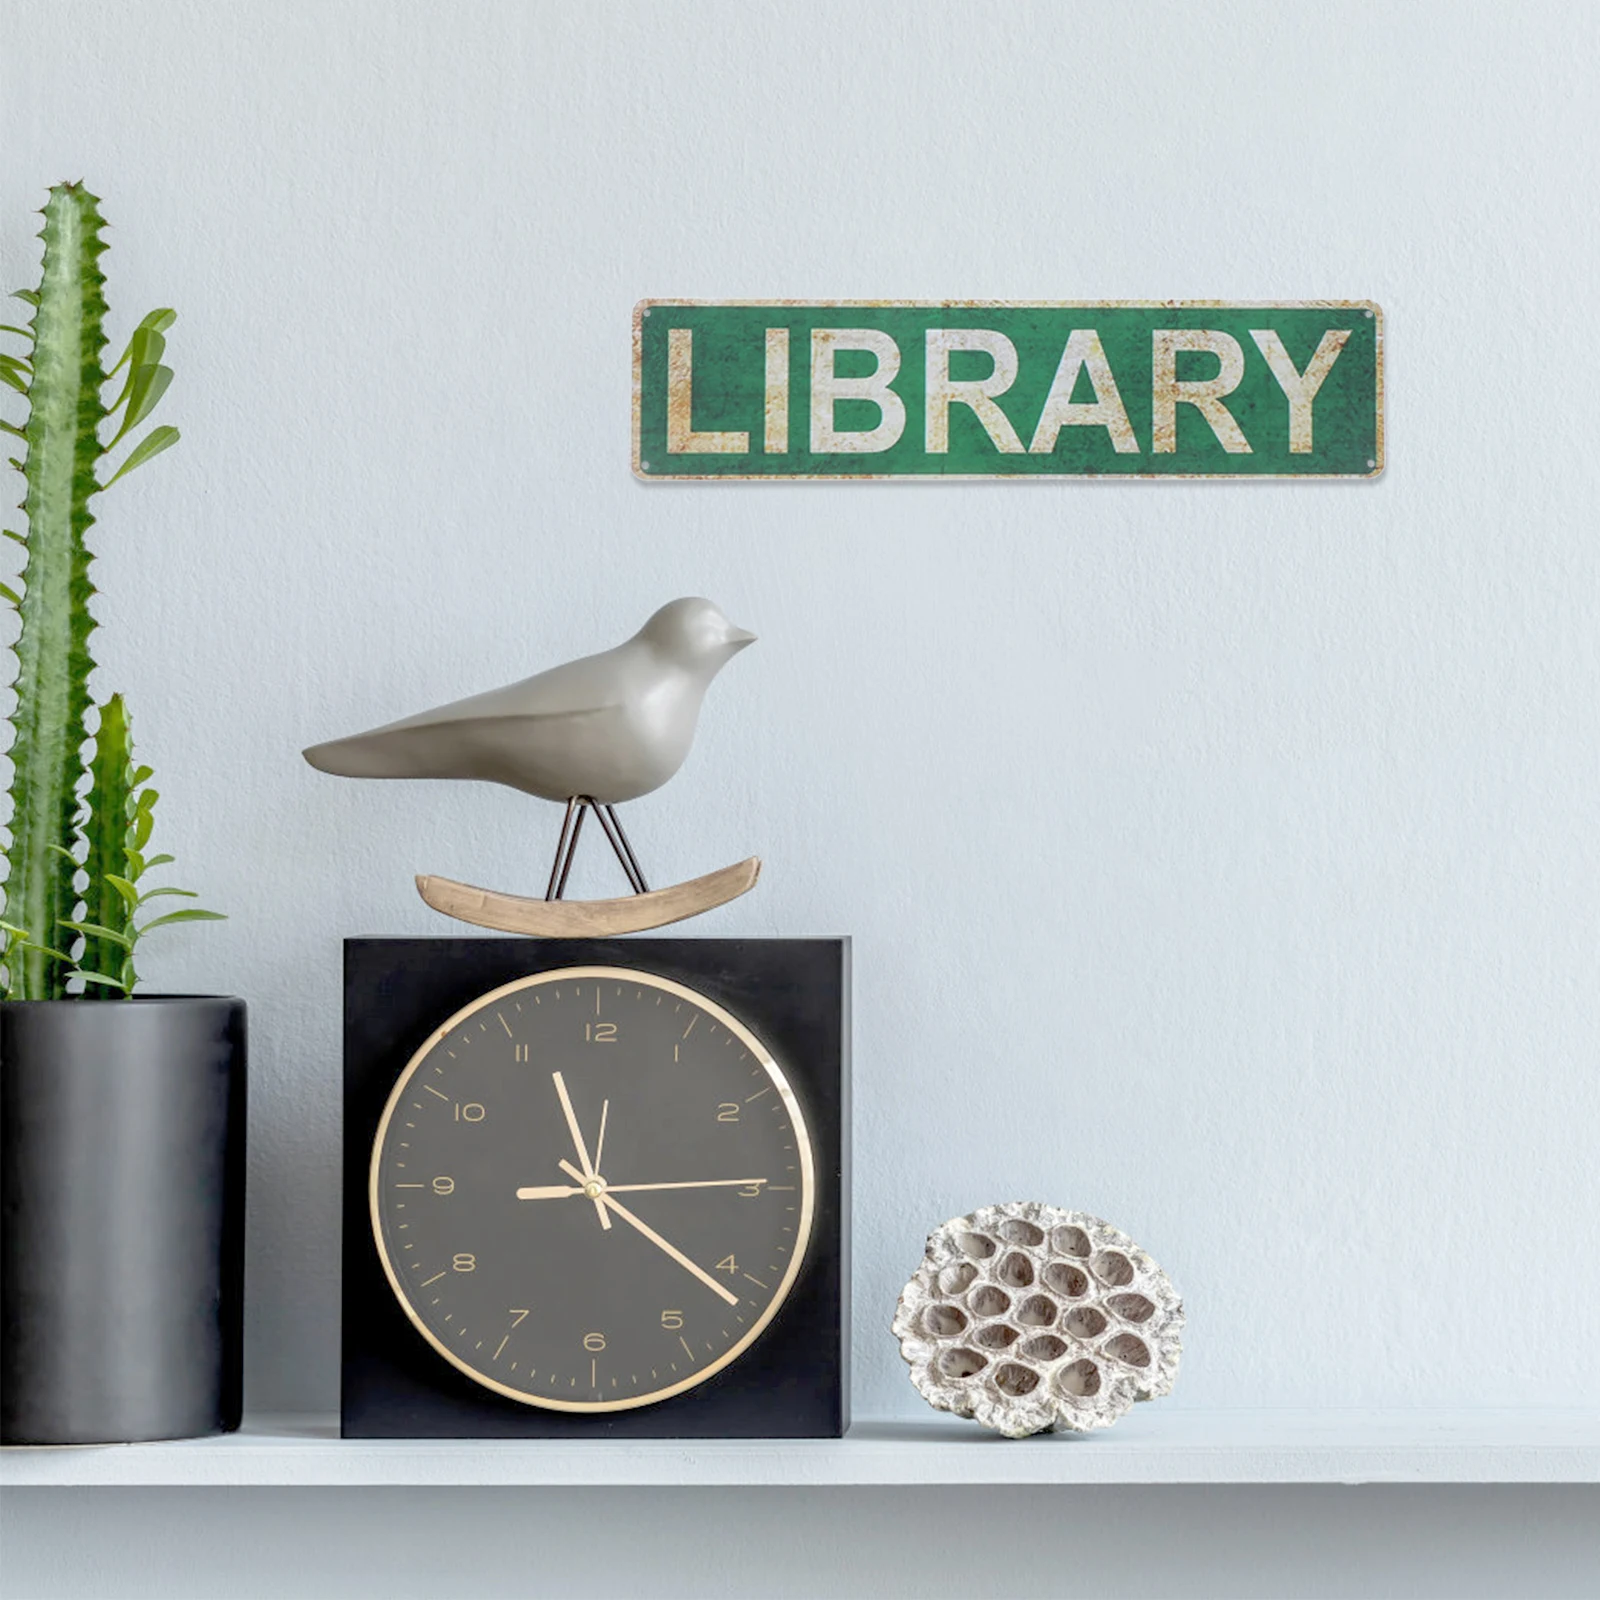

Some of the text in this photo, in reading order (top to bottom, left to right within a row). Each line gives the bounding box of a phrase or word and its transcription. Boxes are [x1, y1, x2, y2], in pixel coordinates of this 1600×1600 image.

[667, 328, 1352, 454] LIBRARY
[585, 1023, 618, 1042] 12
[515, 1044, 529, 1062] 11
[454, 1103, 486, 1122] 10
[717, 1103, 740, 1121] 2
[432, 1176, 455, 1195] 9
[737, 1179, 761, 1197] 3
[452, 1253, 476, 1272] 8
[715, 1254, 739, 1273] 4
[508, 1309, 530, 1327] 7
[661, 1310, 684, 1329] 5
[583, 1333, 606, 1352] 6
